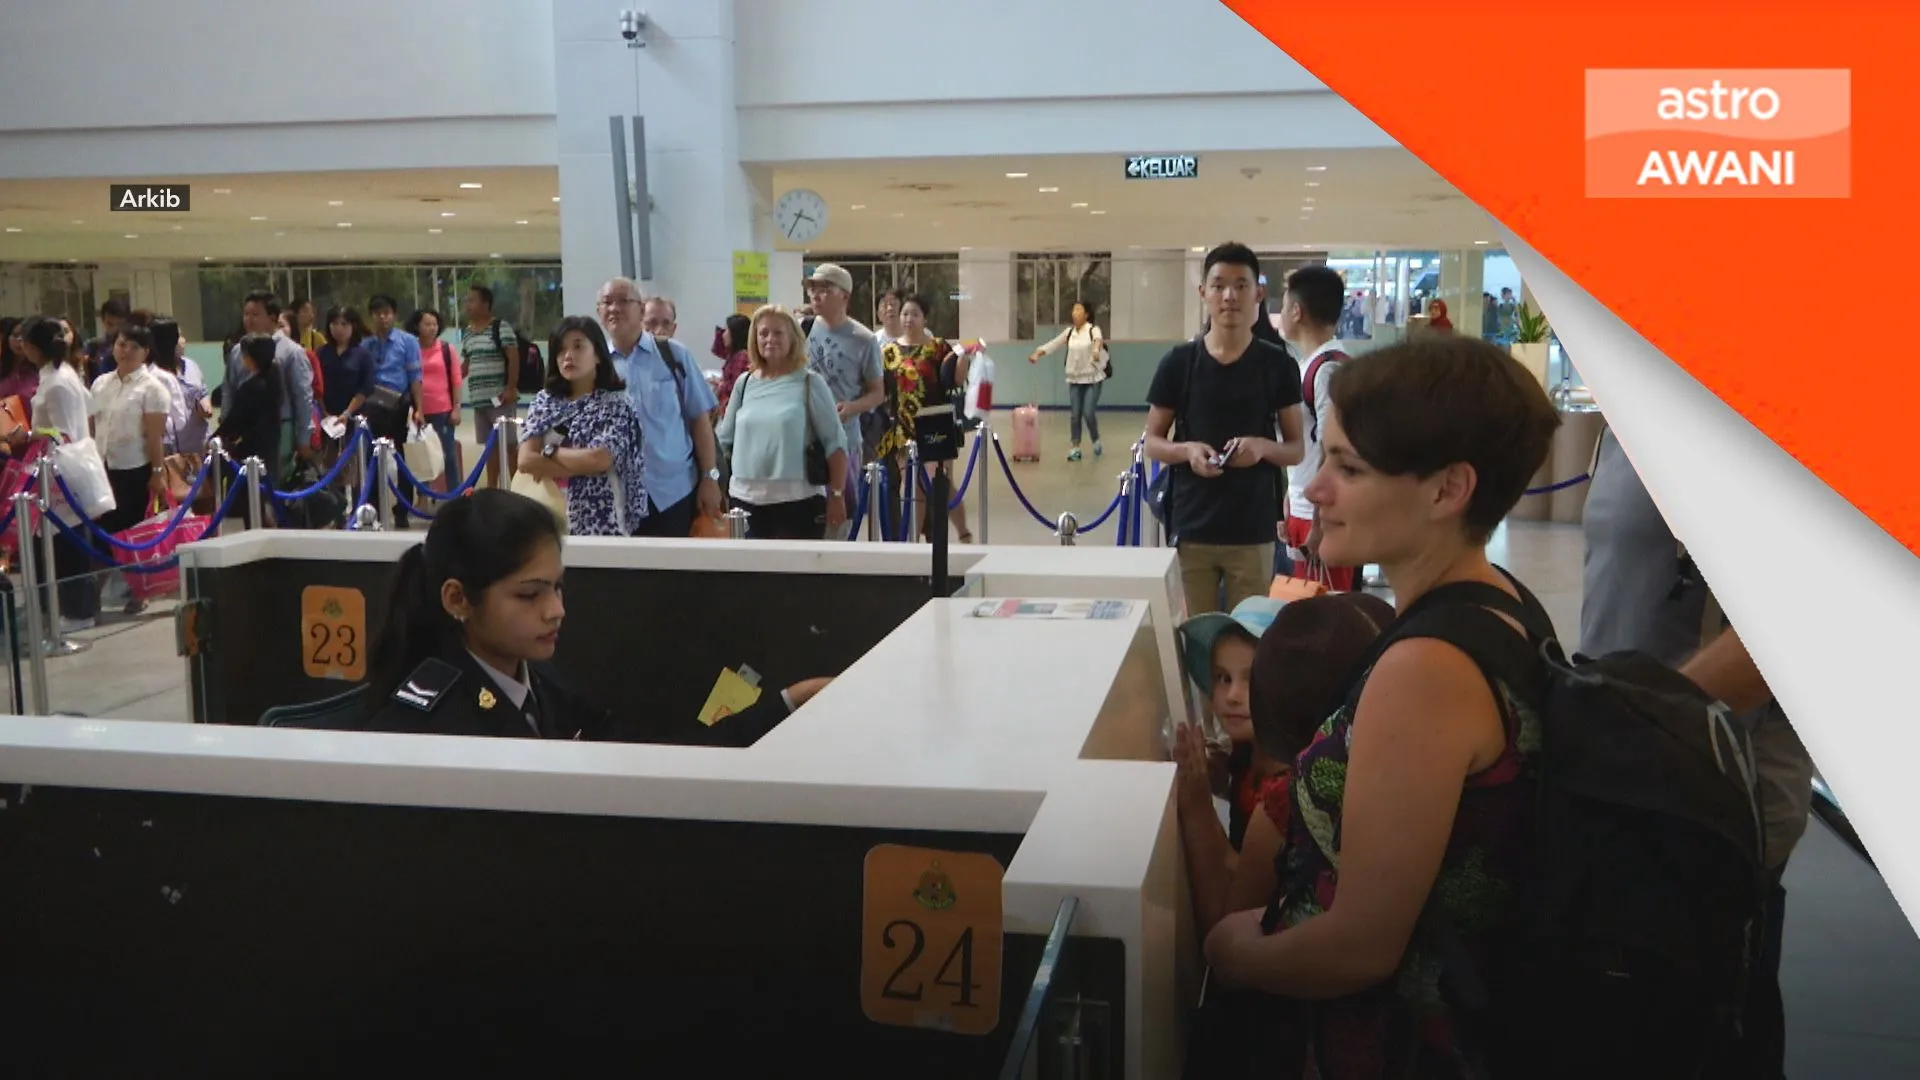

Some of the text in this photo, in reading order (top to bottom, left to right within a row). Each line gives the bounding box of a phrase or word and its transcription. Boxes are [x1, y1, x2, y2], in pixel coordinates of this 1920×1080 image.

[1140, 157, 1196, 178] KELUAR
[310, 622, 356, 667] 23
[881, 919, 981, 1007] 24
